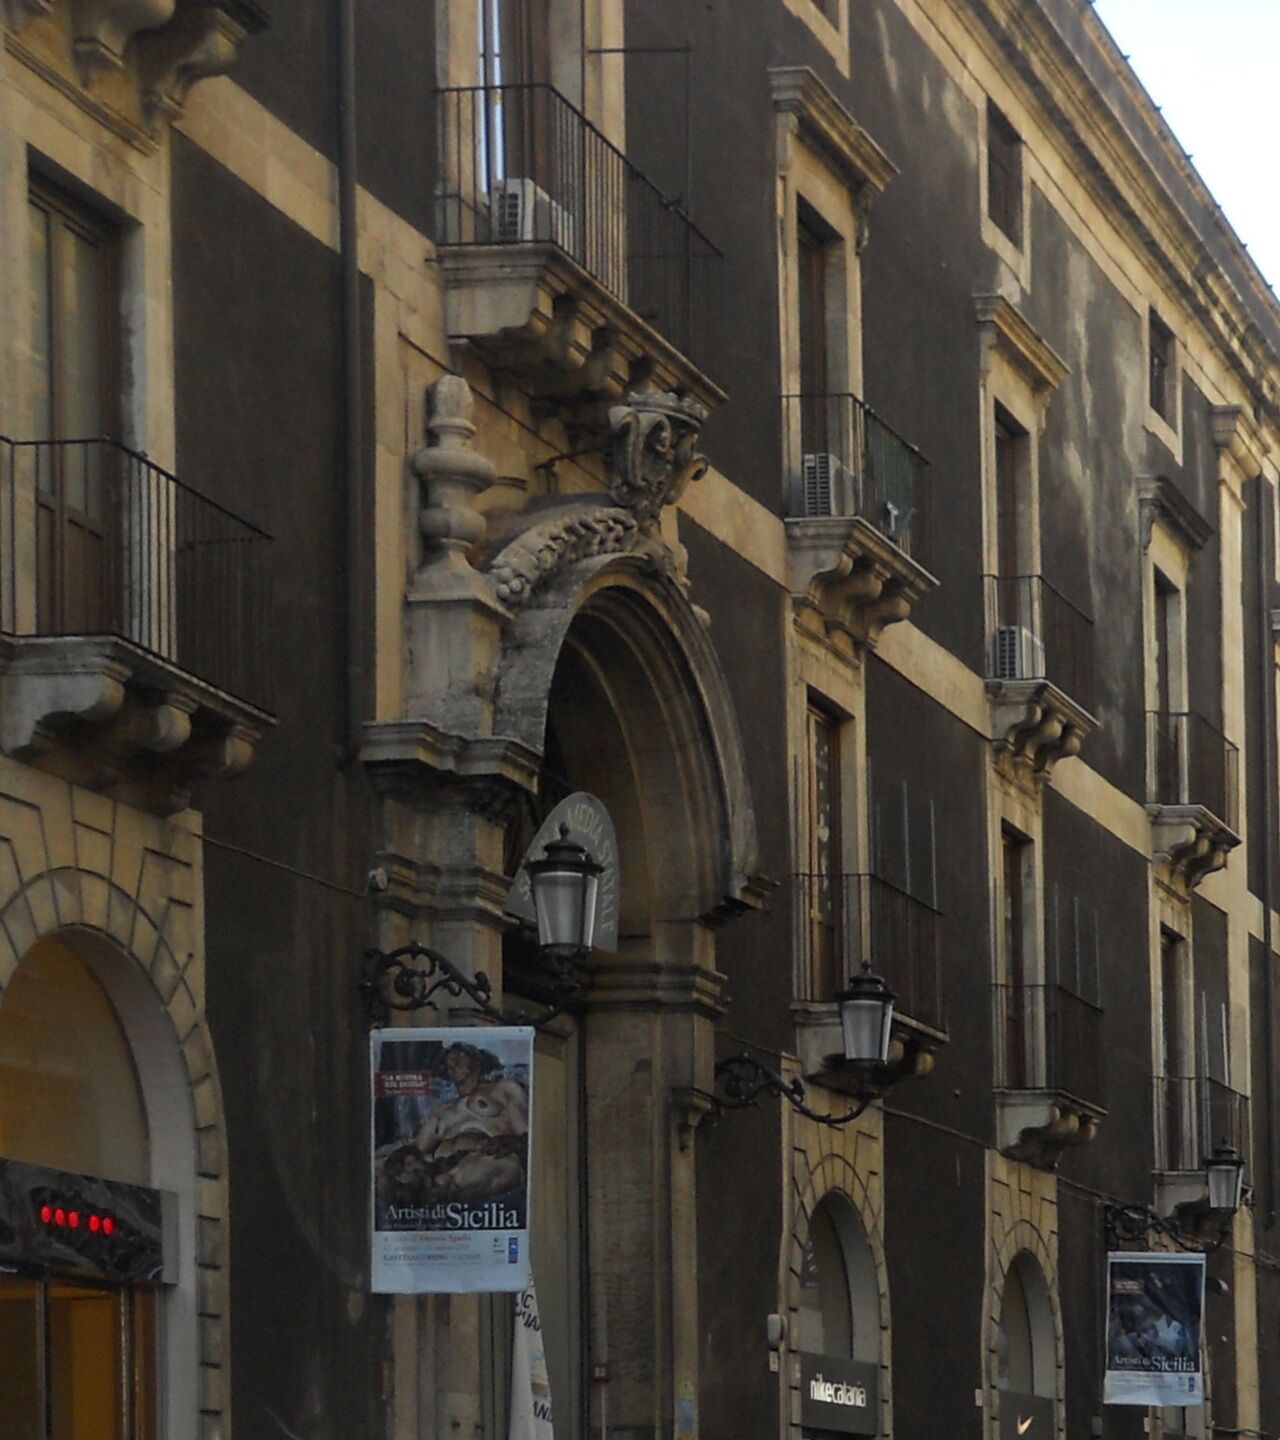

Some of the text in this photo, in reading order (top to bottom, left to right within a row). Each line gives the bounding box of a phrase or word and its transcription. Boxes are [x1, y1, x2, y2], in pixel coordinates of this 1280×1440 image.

[385, 1204, 430, 1220] Artisti
[446, 1202, 519, 1229] Sicilia
[1151, 1354, 1195, 1372] Sicilia
